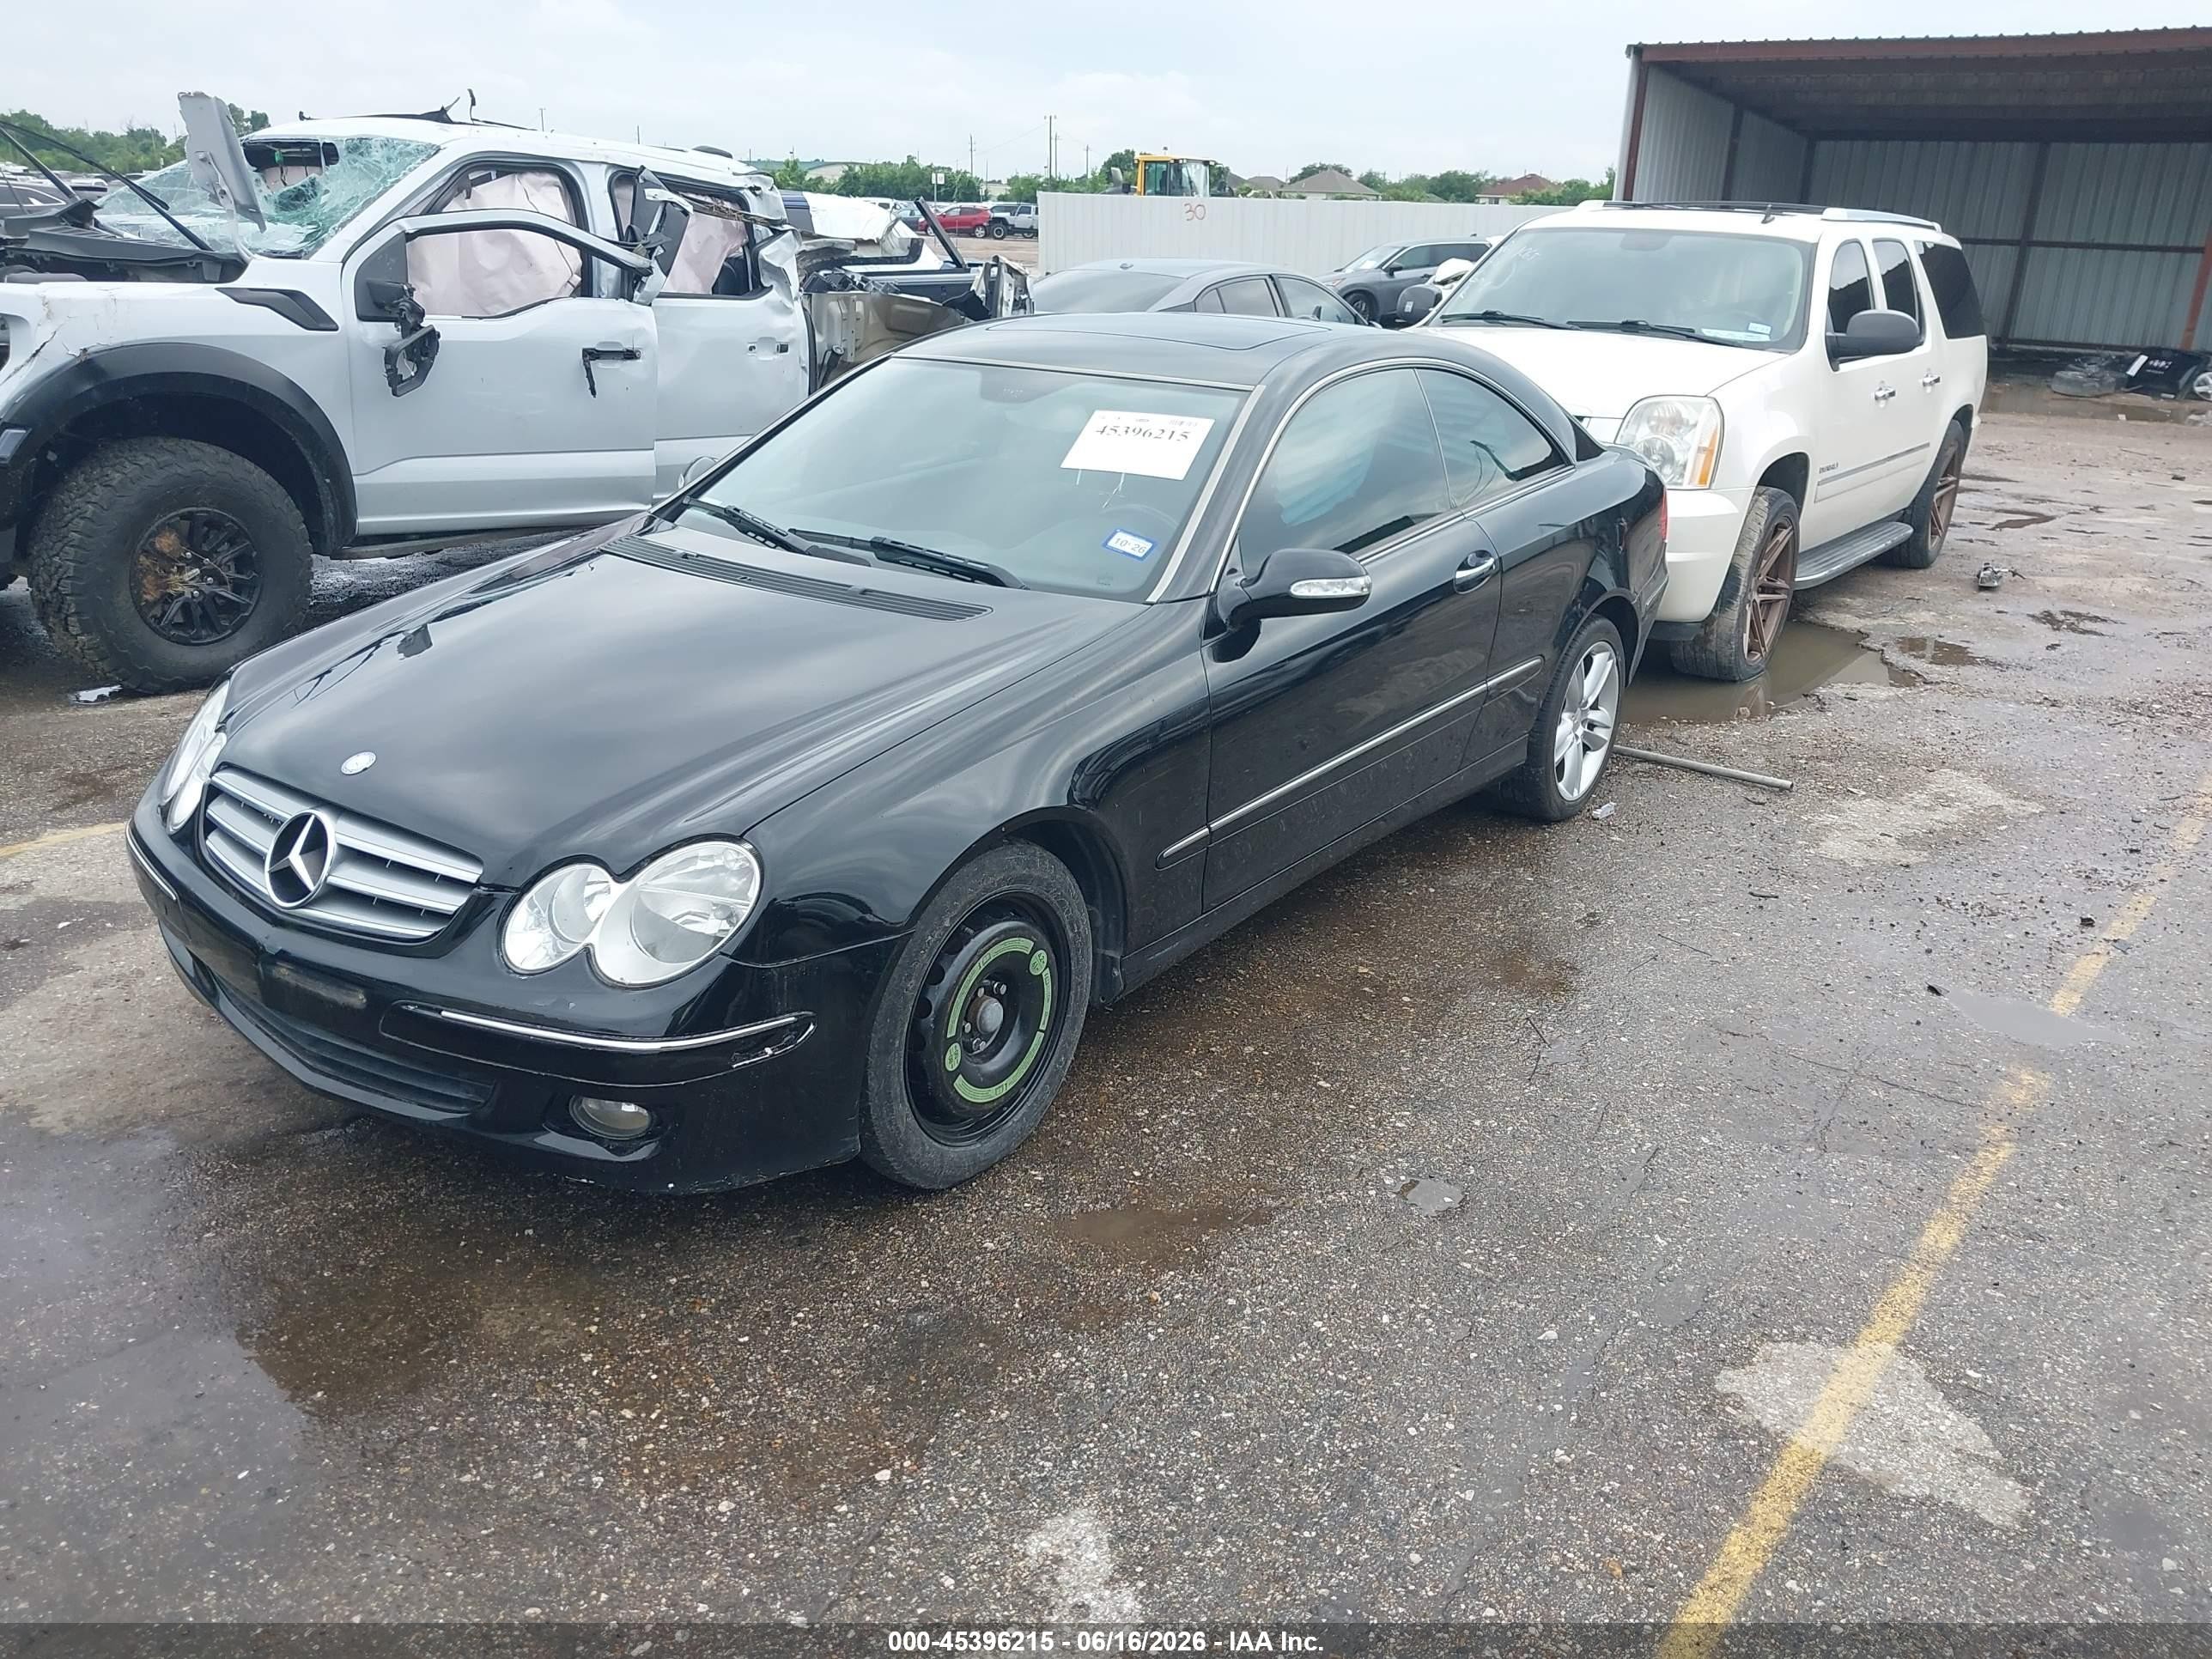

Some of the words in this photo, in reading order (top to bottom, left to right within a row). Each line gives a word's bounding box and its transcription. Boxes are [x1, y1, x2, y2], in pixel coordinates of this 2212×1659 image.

[1183, 202, 1206, 222] 30
[1096, 424, 1192, 442] 45396215
[1115, 538, 1128, 547] 10
[1131, 544, 1147, 554] 26
